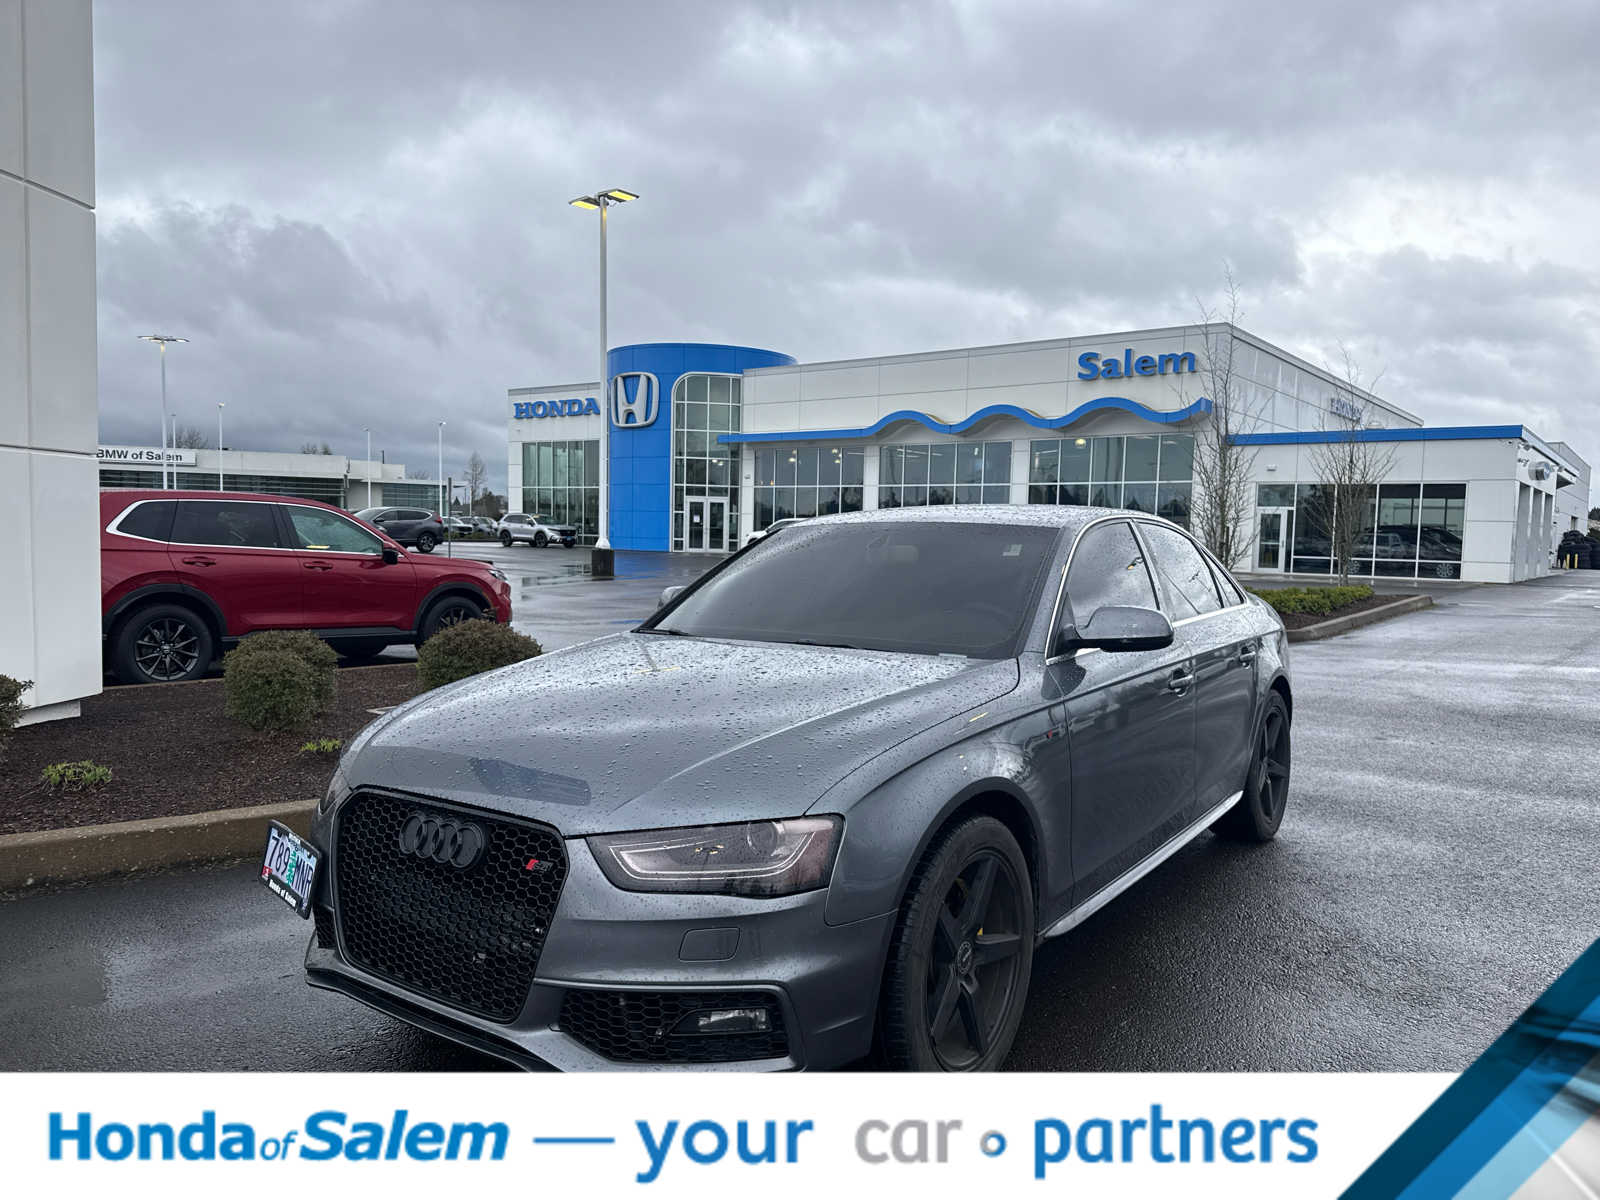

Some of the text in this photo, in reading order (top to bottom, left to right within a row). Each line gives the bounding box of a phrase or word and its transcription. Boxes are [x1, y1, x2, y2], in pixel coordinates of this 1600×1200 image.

[1078, 348, 1197, 380] Salem
[513, 397, 600, 419] HONDA
[97, 449, 183, 462] BMW of Salem
[269, 835, 290, 876] 789
